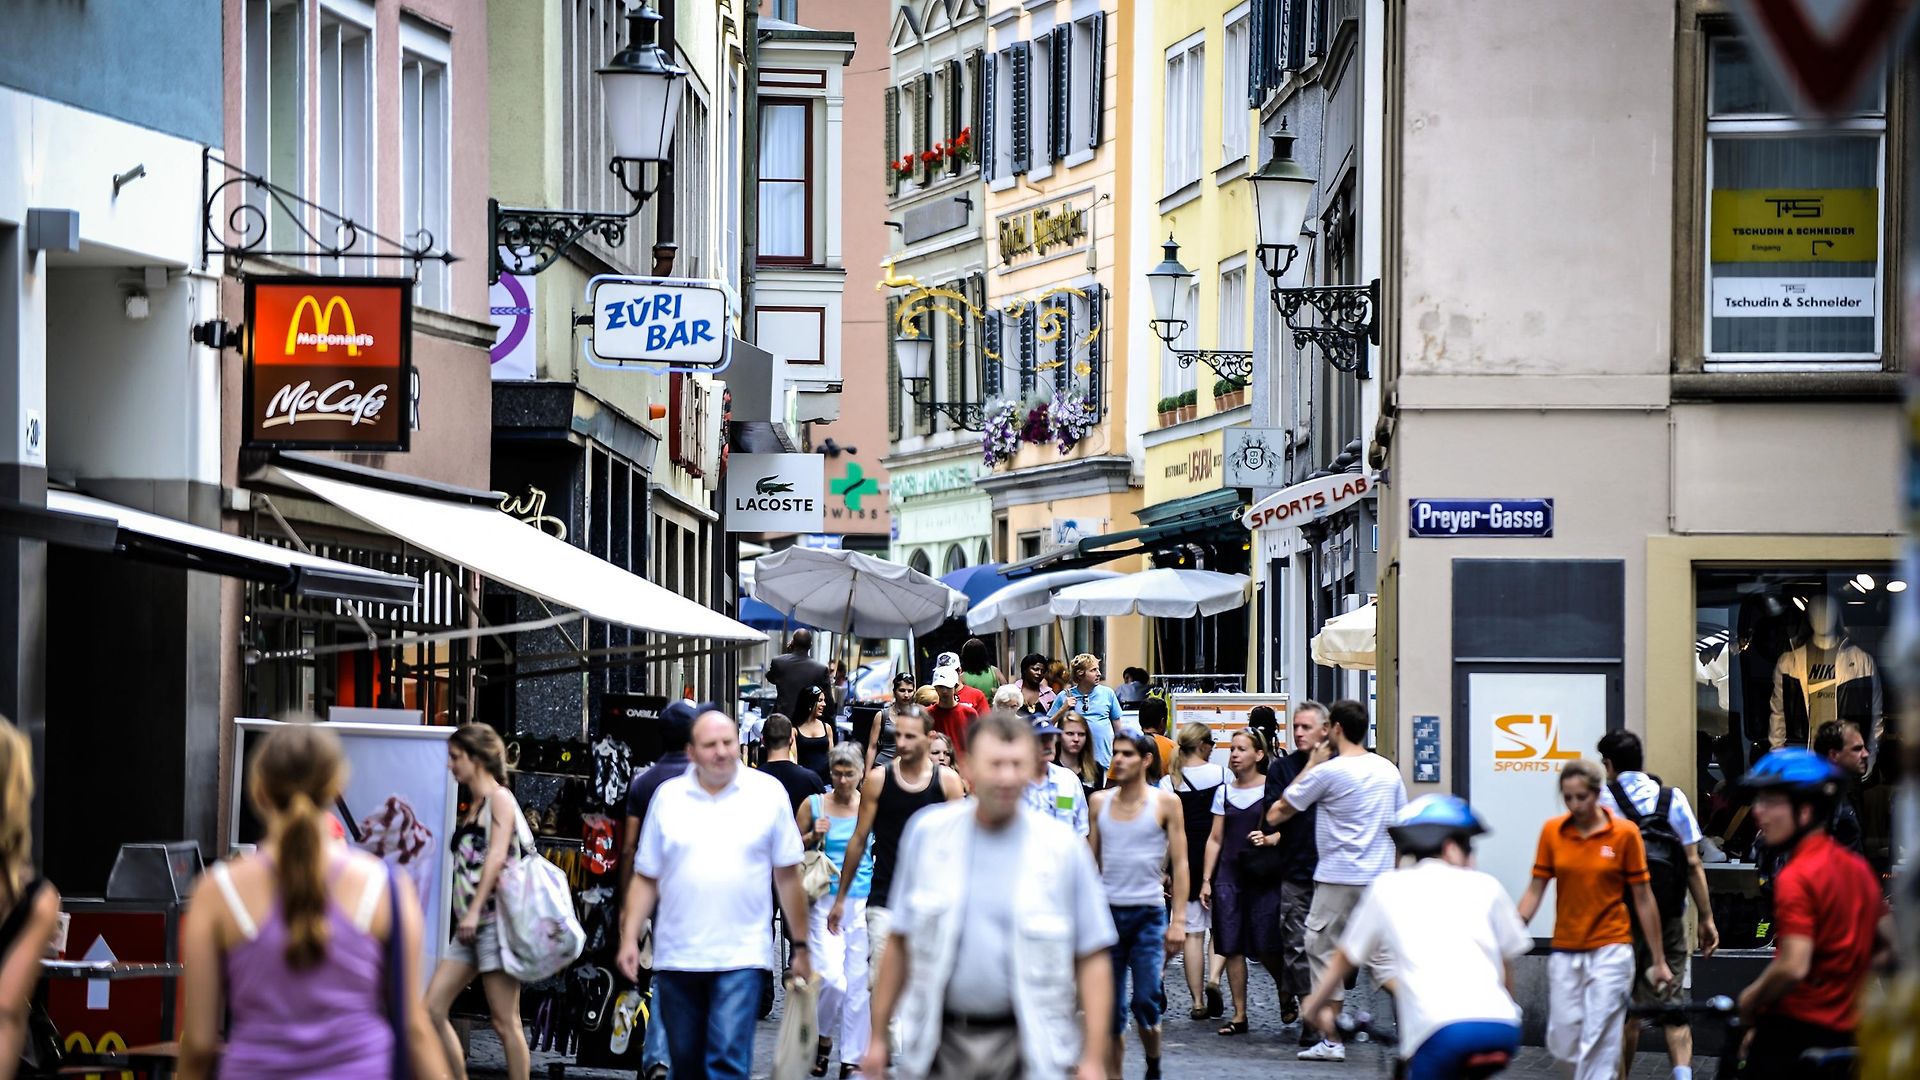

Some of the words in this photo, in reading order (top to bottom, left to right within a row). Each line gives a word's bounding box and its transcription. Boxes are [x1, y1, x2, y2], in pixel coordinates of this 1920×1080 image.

[1732, 227, 1784, 236] TSCHUDIN
[1796, 227, 1856, 236] SCHNEIDER
[1751, 244, 1782, 252] Eingang
[1725, 297, 1780, 308] Tschudin
[1782, 298, 1793, 308] &
[1796, 296, 1862, 308] Schneider
[296, 332, 374, 347] McDonald's
[645, 319, 717, 352] BAR
[736, 497, 814, 512] LACOSTE
[1250, 491, 1327, 529] SPORTS
[1332, 477, 1368, 502] LAB
[1418, 502, 1544, 534] Preyer-Gasse
[1494, 761, 1551, 773] SPORTS
